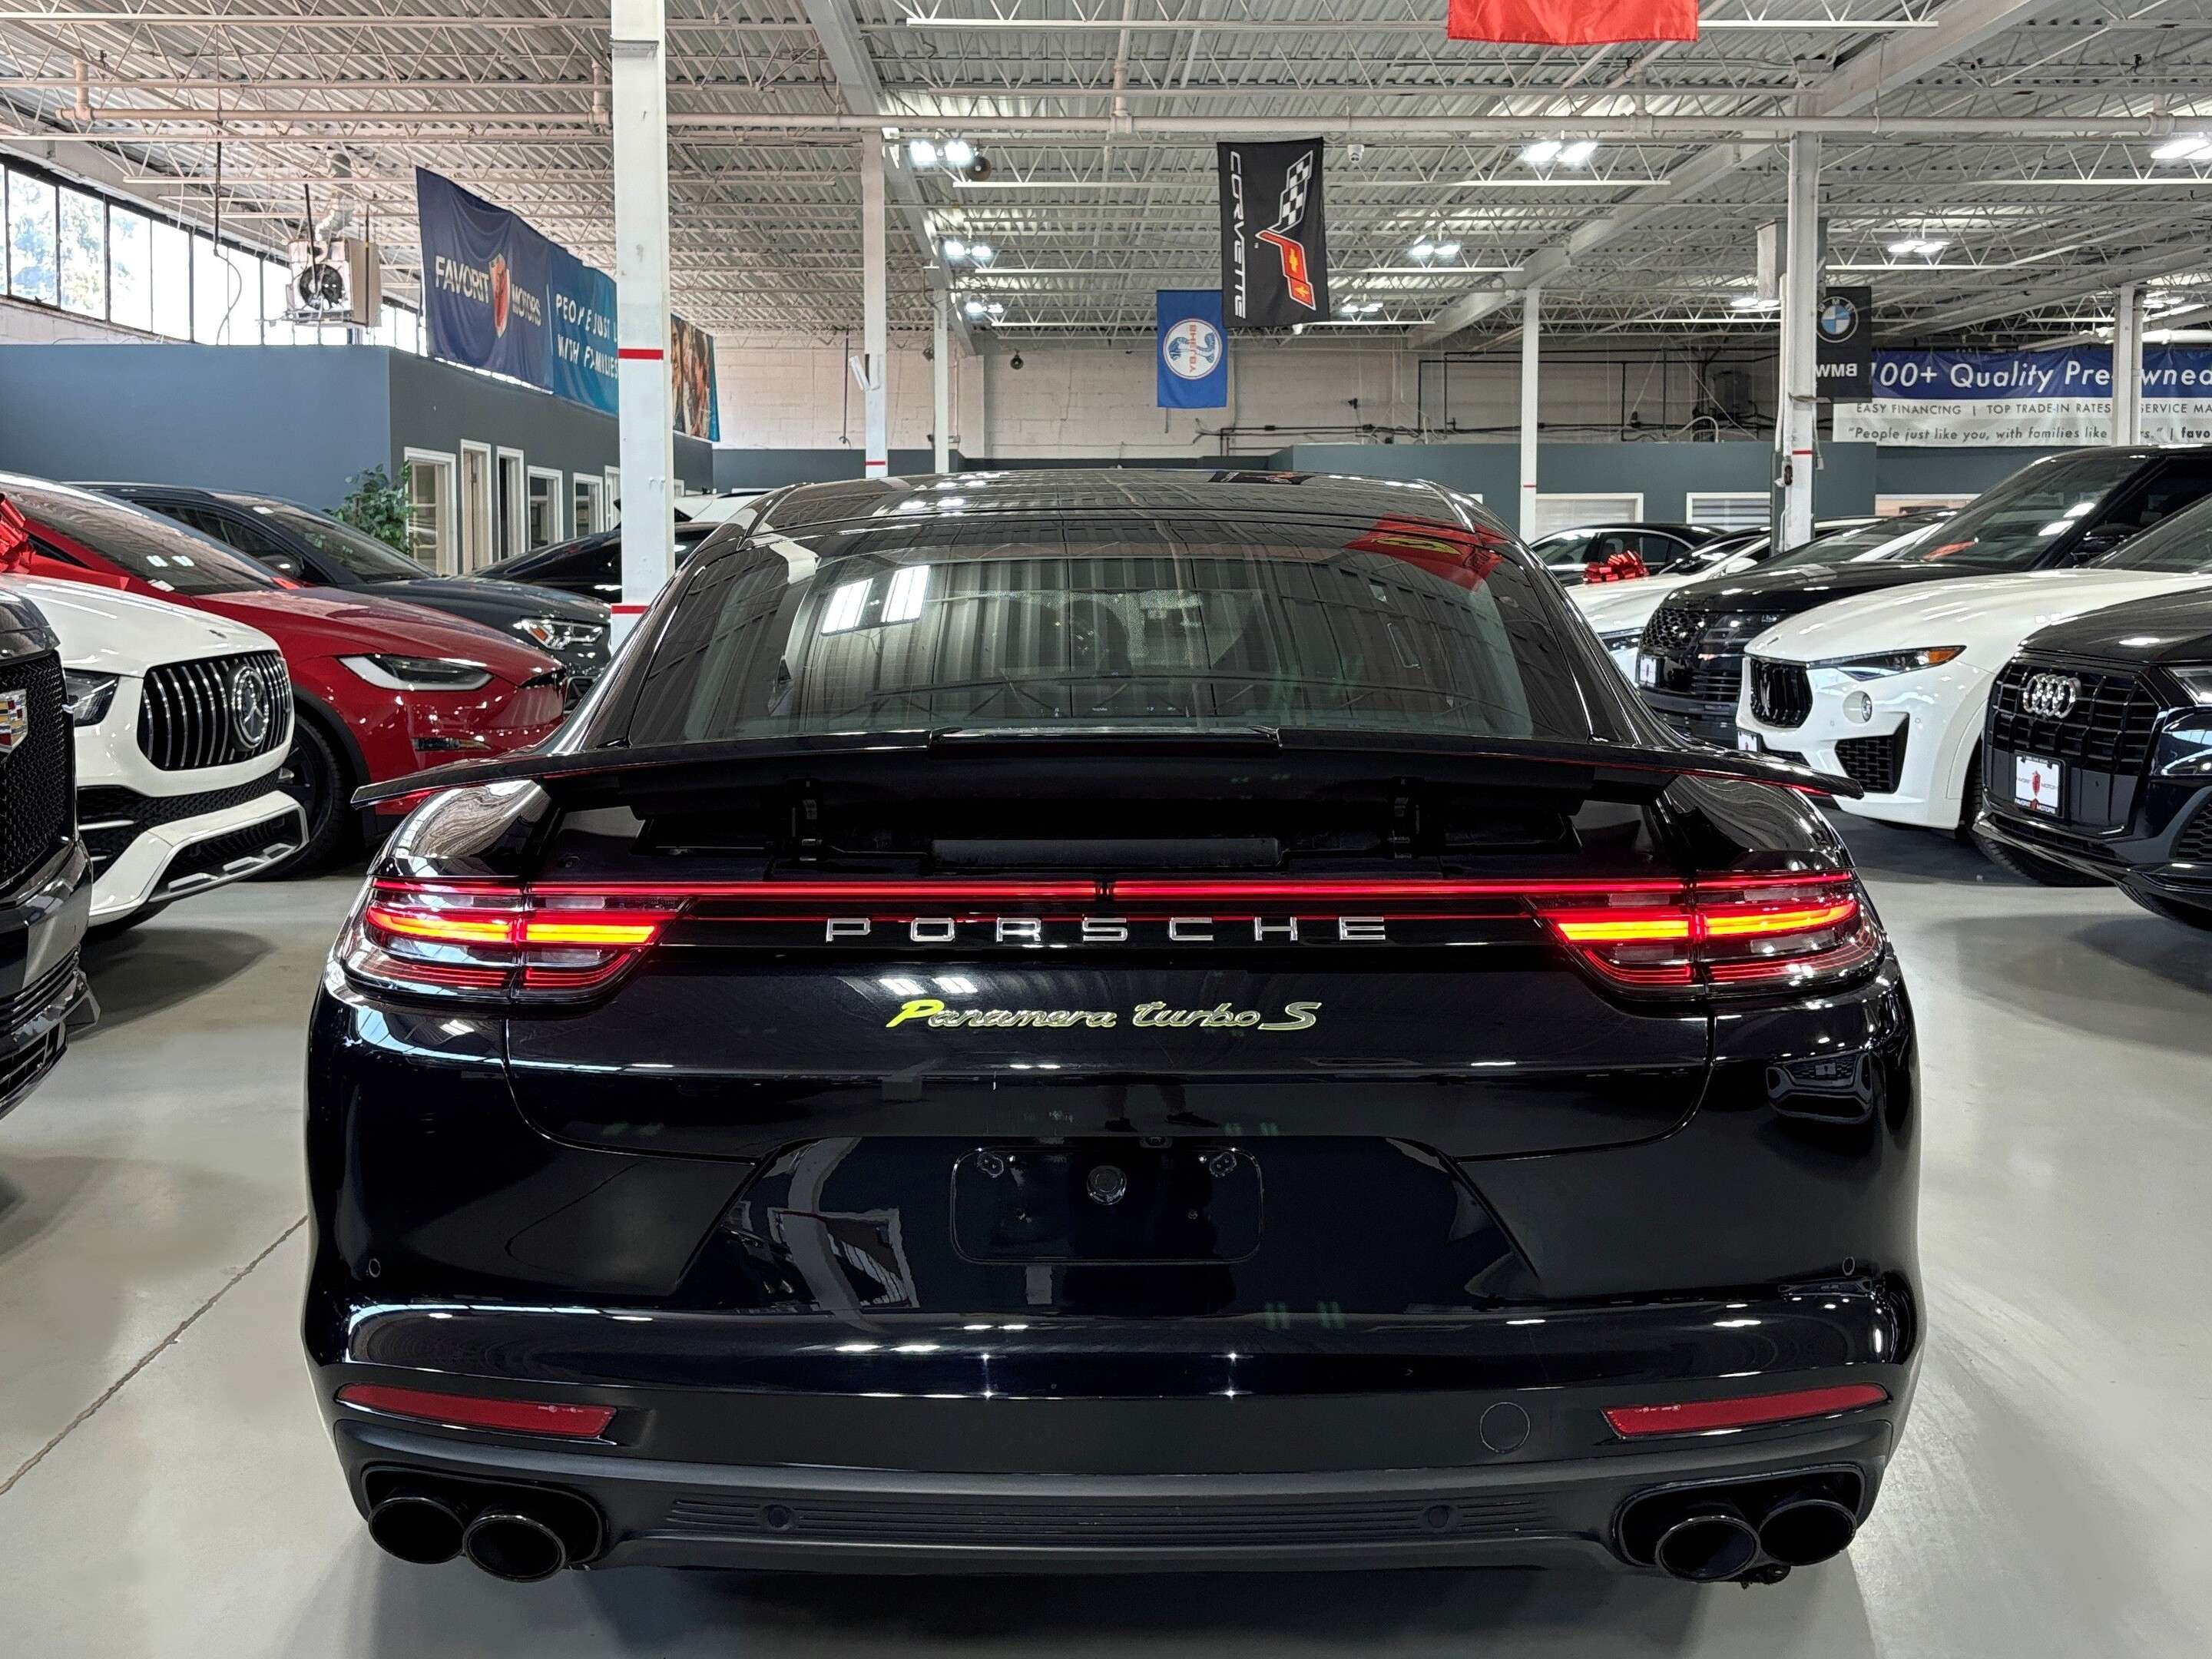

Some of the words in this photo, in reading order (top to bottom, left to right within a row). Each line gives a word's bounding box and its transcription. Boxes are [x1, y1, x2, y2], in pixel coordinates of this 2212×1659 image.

[1230, 151, 1247, 319] CORVETTE
[435, 255, 489, 303] FAVORIT
[512, 283, 541, 326] MOTORS
[556, 293, 592, 332] PEOPE
[593, 313, 610, 339] JUST
[558, 333, 580, 365] WITH
[1950, 360, 2054, 393] Quality
[1856, 403, 1887, 413] EASY
[1892, 404, 1962, 416] FINANCING
[1986, 404, 2011, 415] TOP
[2076, 402, 2112, 414] RATES
[1904, 428, 1930, 442] just
[1934, 427, 1959, 440] like
[1962, 432, 1990, 442] you,
[1996, 426, 2022, 439] with
[2028, 426, 2080, 439] families
[2085, 426, 2108, 439] like
[826, 917, 1386, 944] PORSCHE
[885, 999, 1117, 1029] Panamera
[1132, 1001, 1261, 1028] turbo
[1257, 1001, 1322, 1030] S
